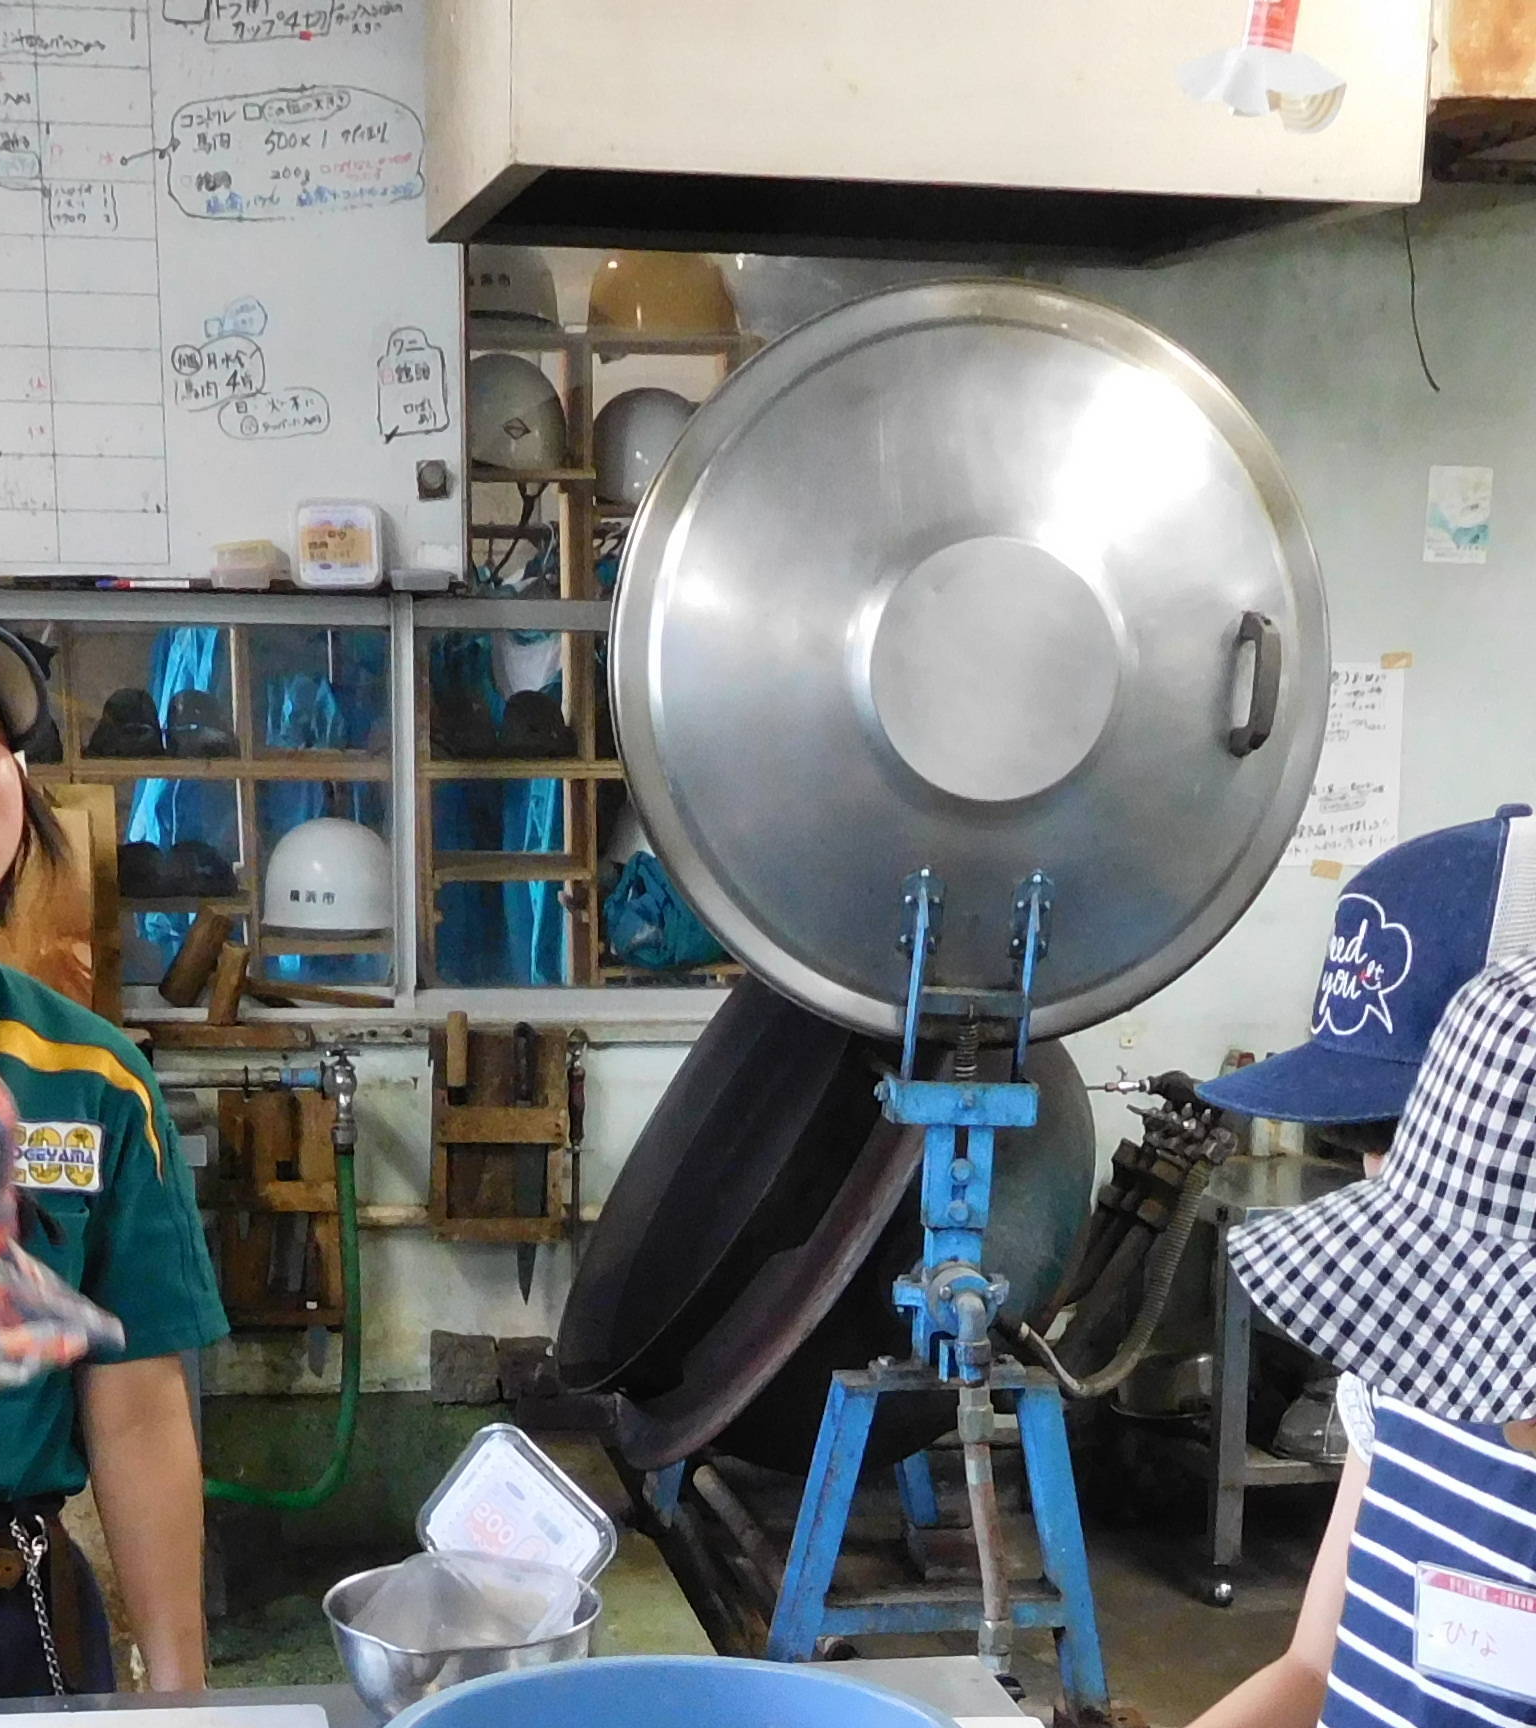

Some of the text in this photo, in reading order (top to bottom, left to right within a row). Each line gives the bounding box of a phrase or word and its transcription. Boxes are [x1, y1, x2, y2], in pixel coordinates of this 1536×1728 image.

[392, 338, 425, 356] ワニ
[12, 1146, 95, 1165] OGEYAMA
[1442, 1619, 1499, 1658] ひな
